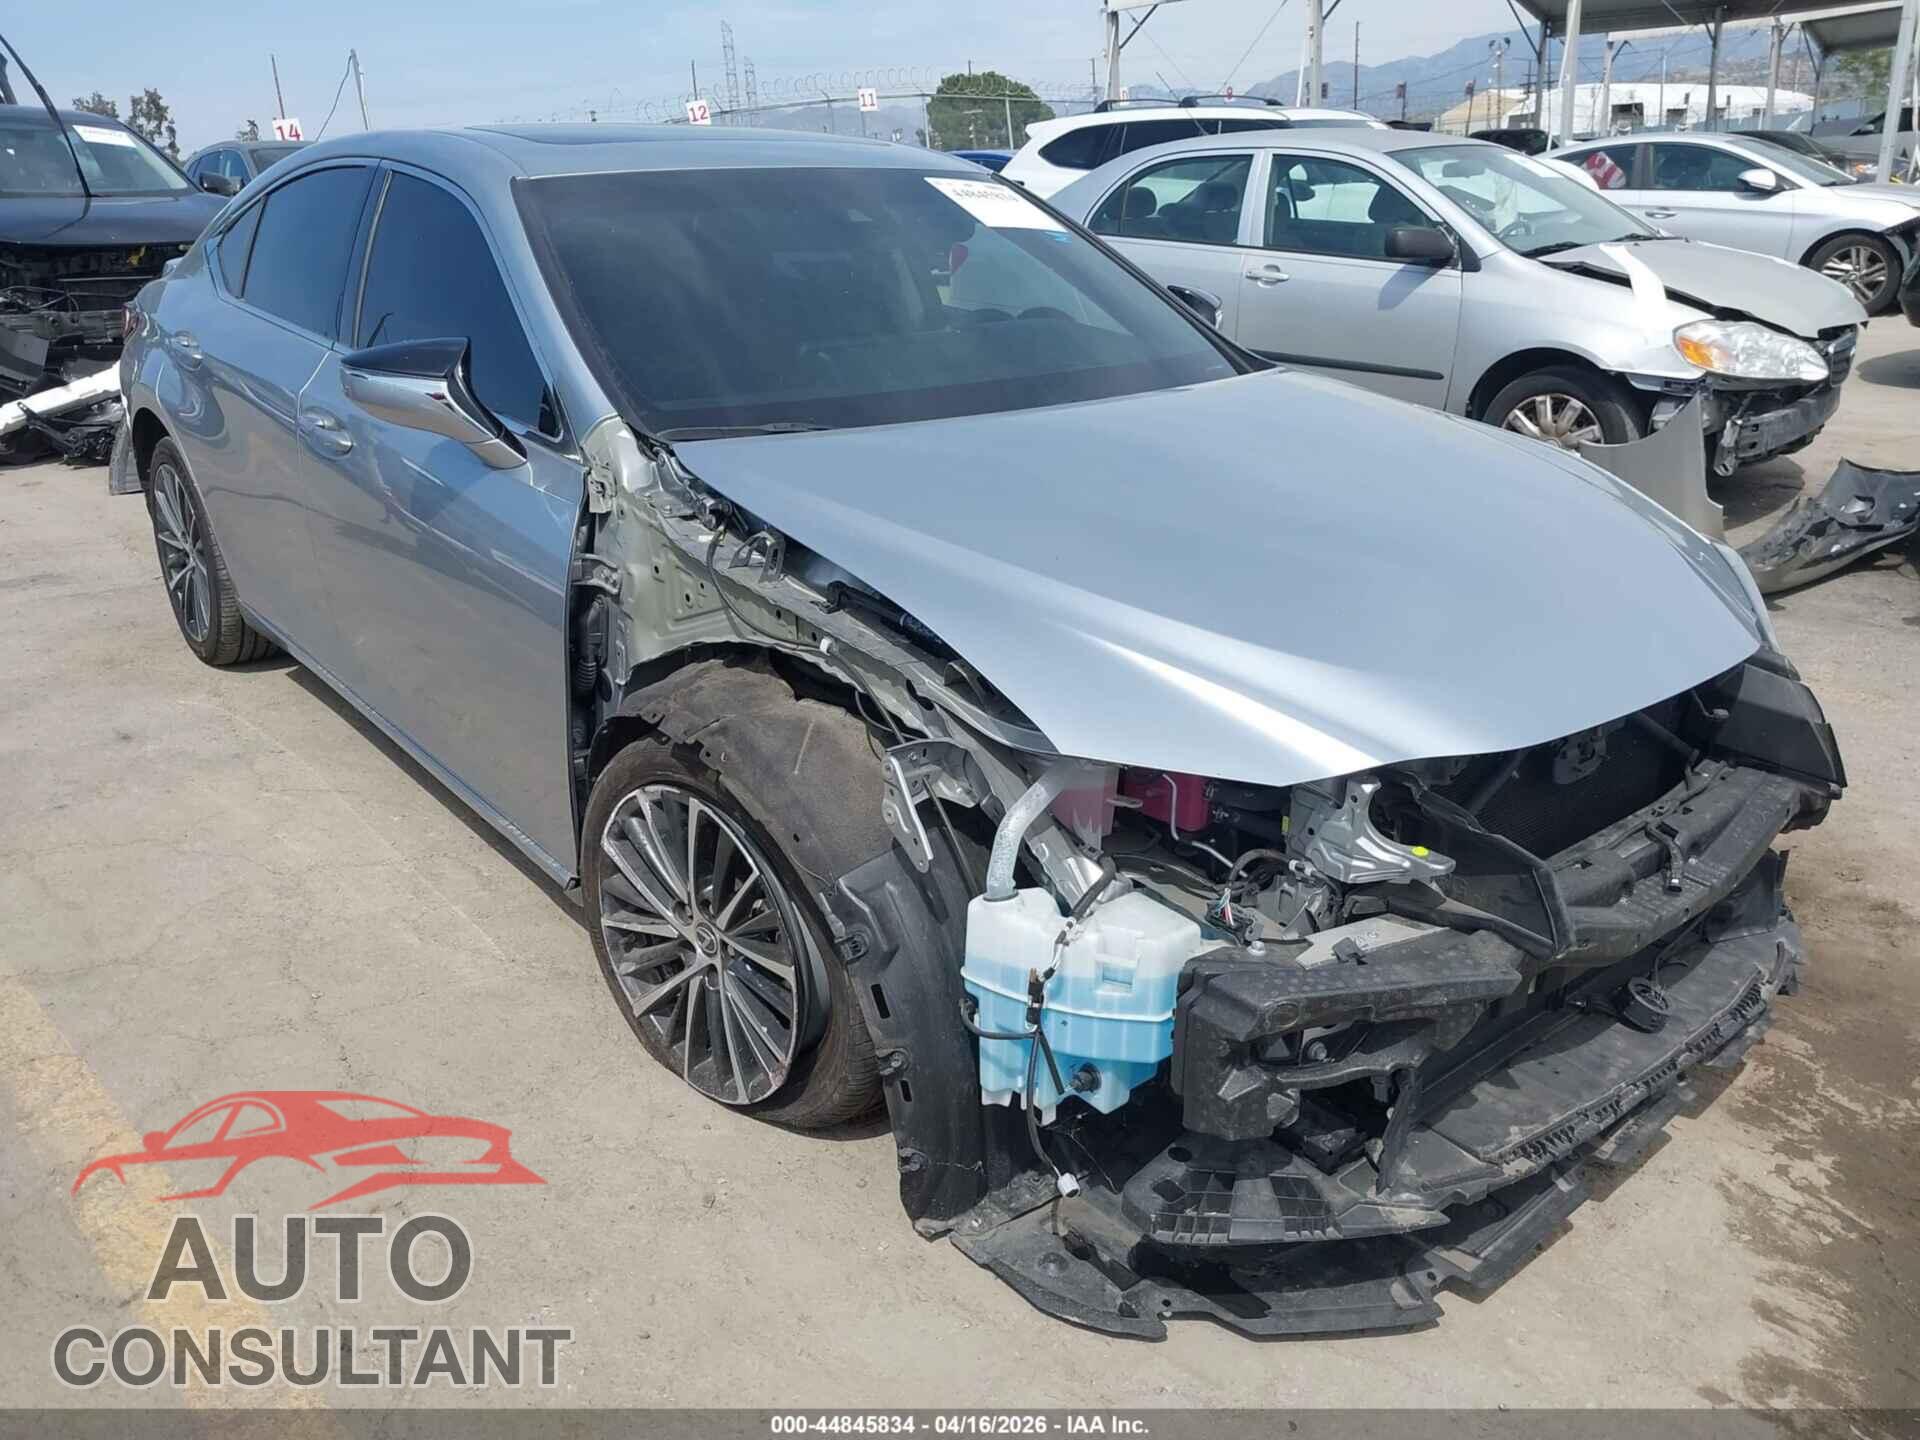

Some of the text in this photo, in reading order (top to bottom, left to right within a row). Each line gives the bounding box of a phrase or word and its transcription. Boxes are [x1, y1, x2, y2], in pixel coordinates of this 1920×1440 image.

[860, 93, 875, 106] 11
[689, 105, 708, 122] 12
[276, 124, 300, 141] 14
